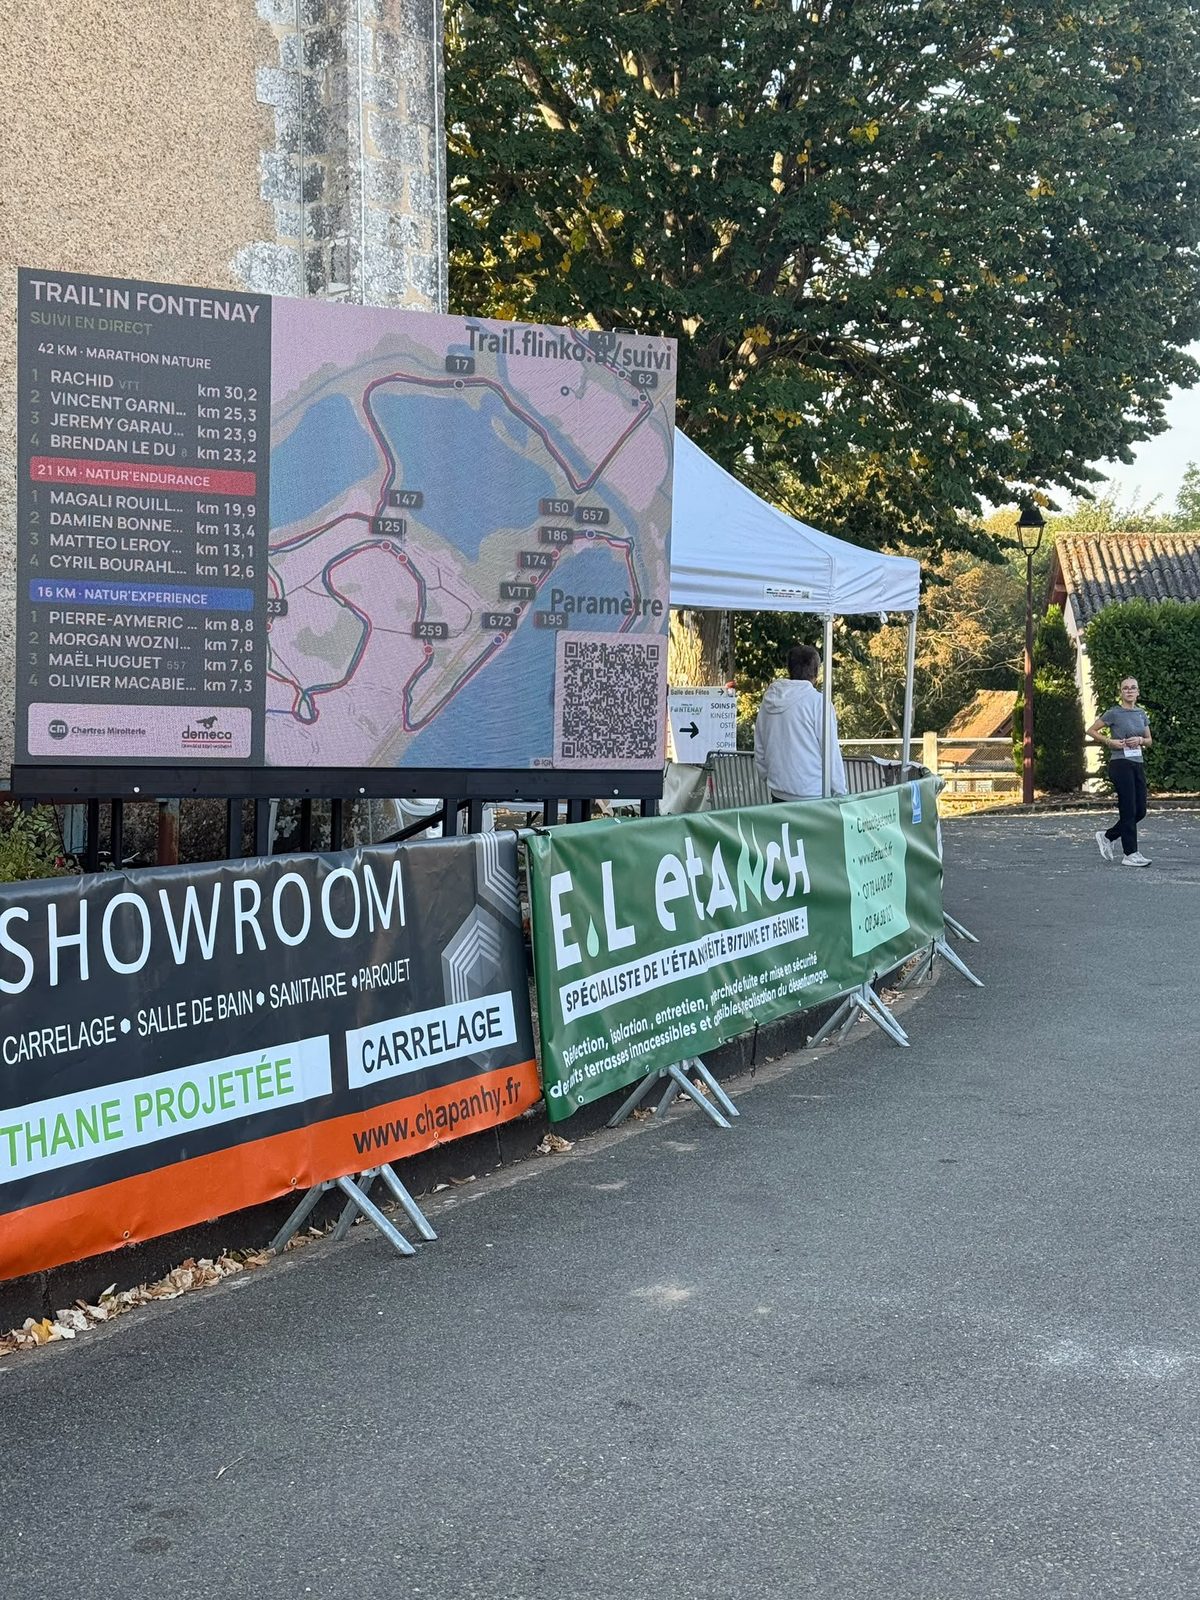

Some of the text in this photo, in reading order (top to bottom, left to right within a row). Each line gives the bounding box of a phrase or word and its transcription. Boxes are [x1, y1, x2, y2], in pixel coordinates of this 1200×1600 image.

[30, 280, 260, 323] TRAIL'IN FONTENAY
[30, 312, 152, 335] SUIVI EN DIRECT
[38, 343, 211, 369] 42 KM MARATHON NATURE
[455, 360, 469, 370] 17
[32, 369, 38, 381] 1
[51, 370, 113, 388] RACHID
[198, 384, 219, 398] km
[224, 387, 257, 402] 30,2
[639, 374, 652, 384] 62
[31, 390, 40, 403] 2
[51, 391, 122, 410] VINCENT
[198, 405, 219, 419] km
[224, 407, 256, 422] 25,3
[31, 412, 39, 425] 3
[51, 413, 114, 430] JEREMY
[198, 426, 219, 439] km
[224, 428, 256, 442] 23,9
[30, 433, 39, 446] 4
[51, 435, 128, 452] BRENDAN
[132, 441, 149, 454] LE
[153, 443, 176, 456] DU
[197, 446, 219, 460] km
[224, 448, 256, 463] 23,2
[38, 465, 210, 486] 21 KM NATUR'ENDURANCE
[32, 490, 37, 502] 1
[50, 491, 112, 507] MAGALI
[197, 501, 219, 514] km
[224, 503, 256, 517] 19,9
[396, 495, 417, 505] 147
[548, 502, 568, 513] 150
[30, 512, 39, 524] 2
[50, 513, 113, 528] DAMIEN
[197, 522, 218, 535] km
[223, 524, 255, 538] 13,4
[378, 521, 400, 531] 125
[582, 510, 603, 521] 657
[30, 534, 38, 545] 3
[50, 534, 116, 549] MATTEO
[196, 543, 218, 555] km
[223, 544, 253, 557] 13,1
[547, 529, 568, 541] 186
[29, 554, 38, 566] 4
[50, 555, 97, 569] CYRIL
[196, 563, 218, 576] km
[223, 564, 254, 578] 12,6
[525, 555, 546, 566] 174
[38, 587, 207, 604] 16 KM NATUR'EXPERIENCE
[508, 587, 530, 596] VTT
[551, 589, 663, 616] Paramètre
[31, 611, 254, 633] 1 PIERRE-AYMERIC km 8,8
[420, 626, 442, 636] 259
[489, 616, 512, 626] 672
[542, 615, 562, 625] 195
[29, 632, 39, 644] 2
[50, 633, 122, 646] MORGAN
[204, 639, 226, 650] km
[231, 640, 253, 653] 7,8
[29, 653, 37, 665] 3
[49, 651, 93, 667] MAËL
[96, 655, 162, 669] HUGUET
[204, 659, 226, 671] km
[231, 660, 253, 673] 7,6
[29, 674, 38, 686] 4
[49, 674, 111, 688] OLIVIER
[204, 679, 226, 690] km
[230, 680, 252, 693] 7,3
[182, 725, 232, 739] demeco
[0, 860, 405, 994] SHOWROOM
[566, 967, 641, 1012] SPÉCIALISTE
[644, 961, 658, 982] DE
[728, 929, 759, 952] BITUME
[761, 925, 770, 942] ET
[773, 916, 799, 938] RÉSINE
[2, 958, 410, 1064] CARRELAGE SALLE DE BAIN SANITAIRE PARQUET
[610, 1018, 648, 1045] isolation
[655, 996, 708, 1024] entretien,
[760, 970, 768, 984] et
[784, 962, 792, 975] en
[362, 1007, 503, 1073] CARRELAGE
[585, 1051, 630, 1078] terrasses
[629, 1022, 697, 1058] innacessibles
[700, 1016, 712, 1031] et
[778, 984, 787, 997] du
[0, 1054, 294, 1166] THANE PROJETÉE
[353, 1076, 521, 1154] www.chapanhy.fr
